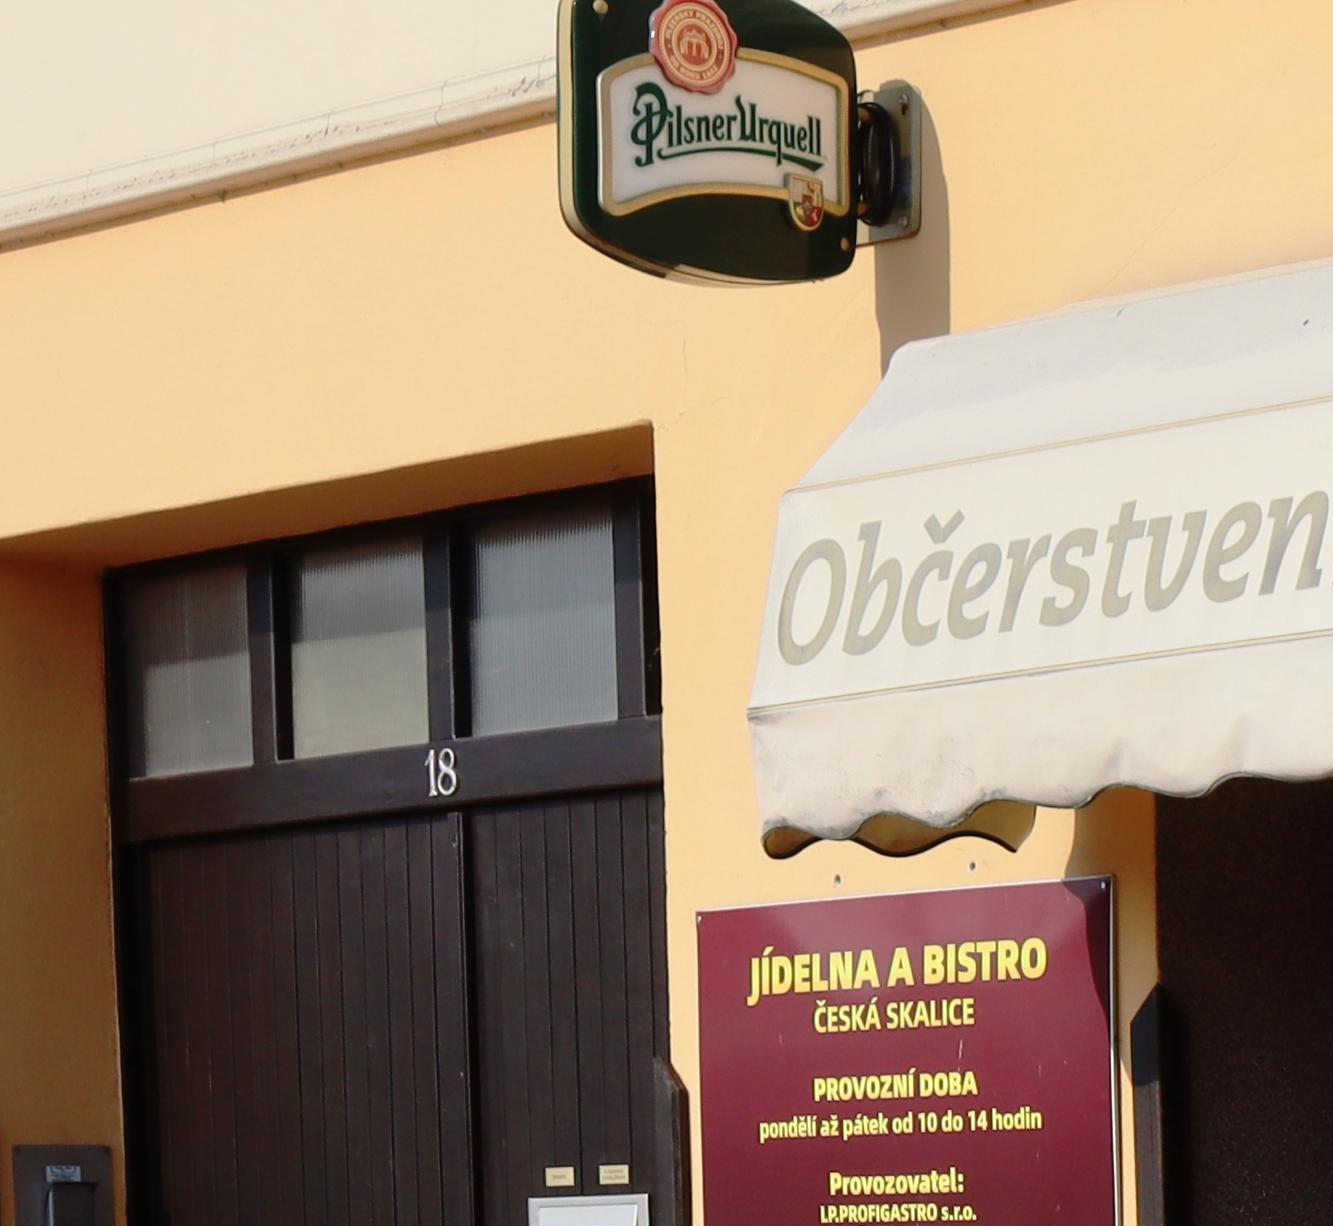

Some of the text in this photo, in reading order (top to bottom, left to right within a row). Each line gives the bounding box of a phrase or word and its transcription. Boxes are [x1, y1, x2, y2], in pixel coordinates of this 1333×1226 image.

[629, 81, 822, 168] Pilsner Urquell
[424, 747, 458, 798] 18
[746, 937, 1047, 1007] JÍDELNA A BISTRO
[814, 996, 975, 1033] ČESKÁ SKALICE
[814, 1067, 978, 1102] PROVOZNÍ DOBA
[759, 1106, 1042, 1144] pondělí až pátek od 10 do 14 hodin
[829, 1166, 964, 1196] Provozovatel:
[820, 1202, 977, 1224] LP.PROFIGASTRO s.r.o.
